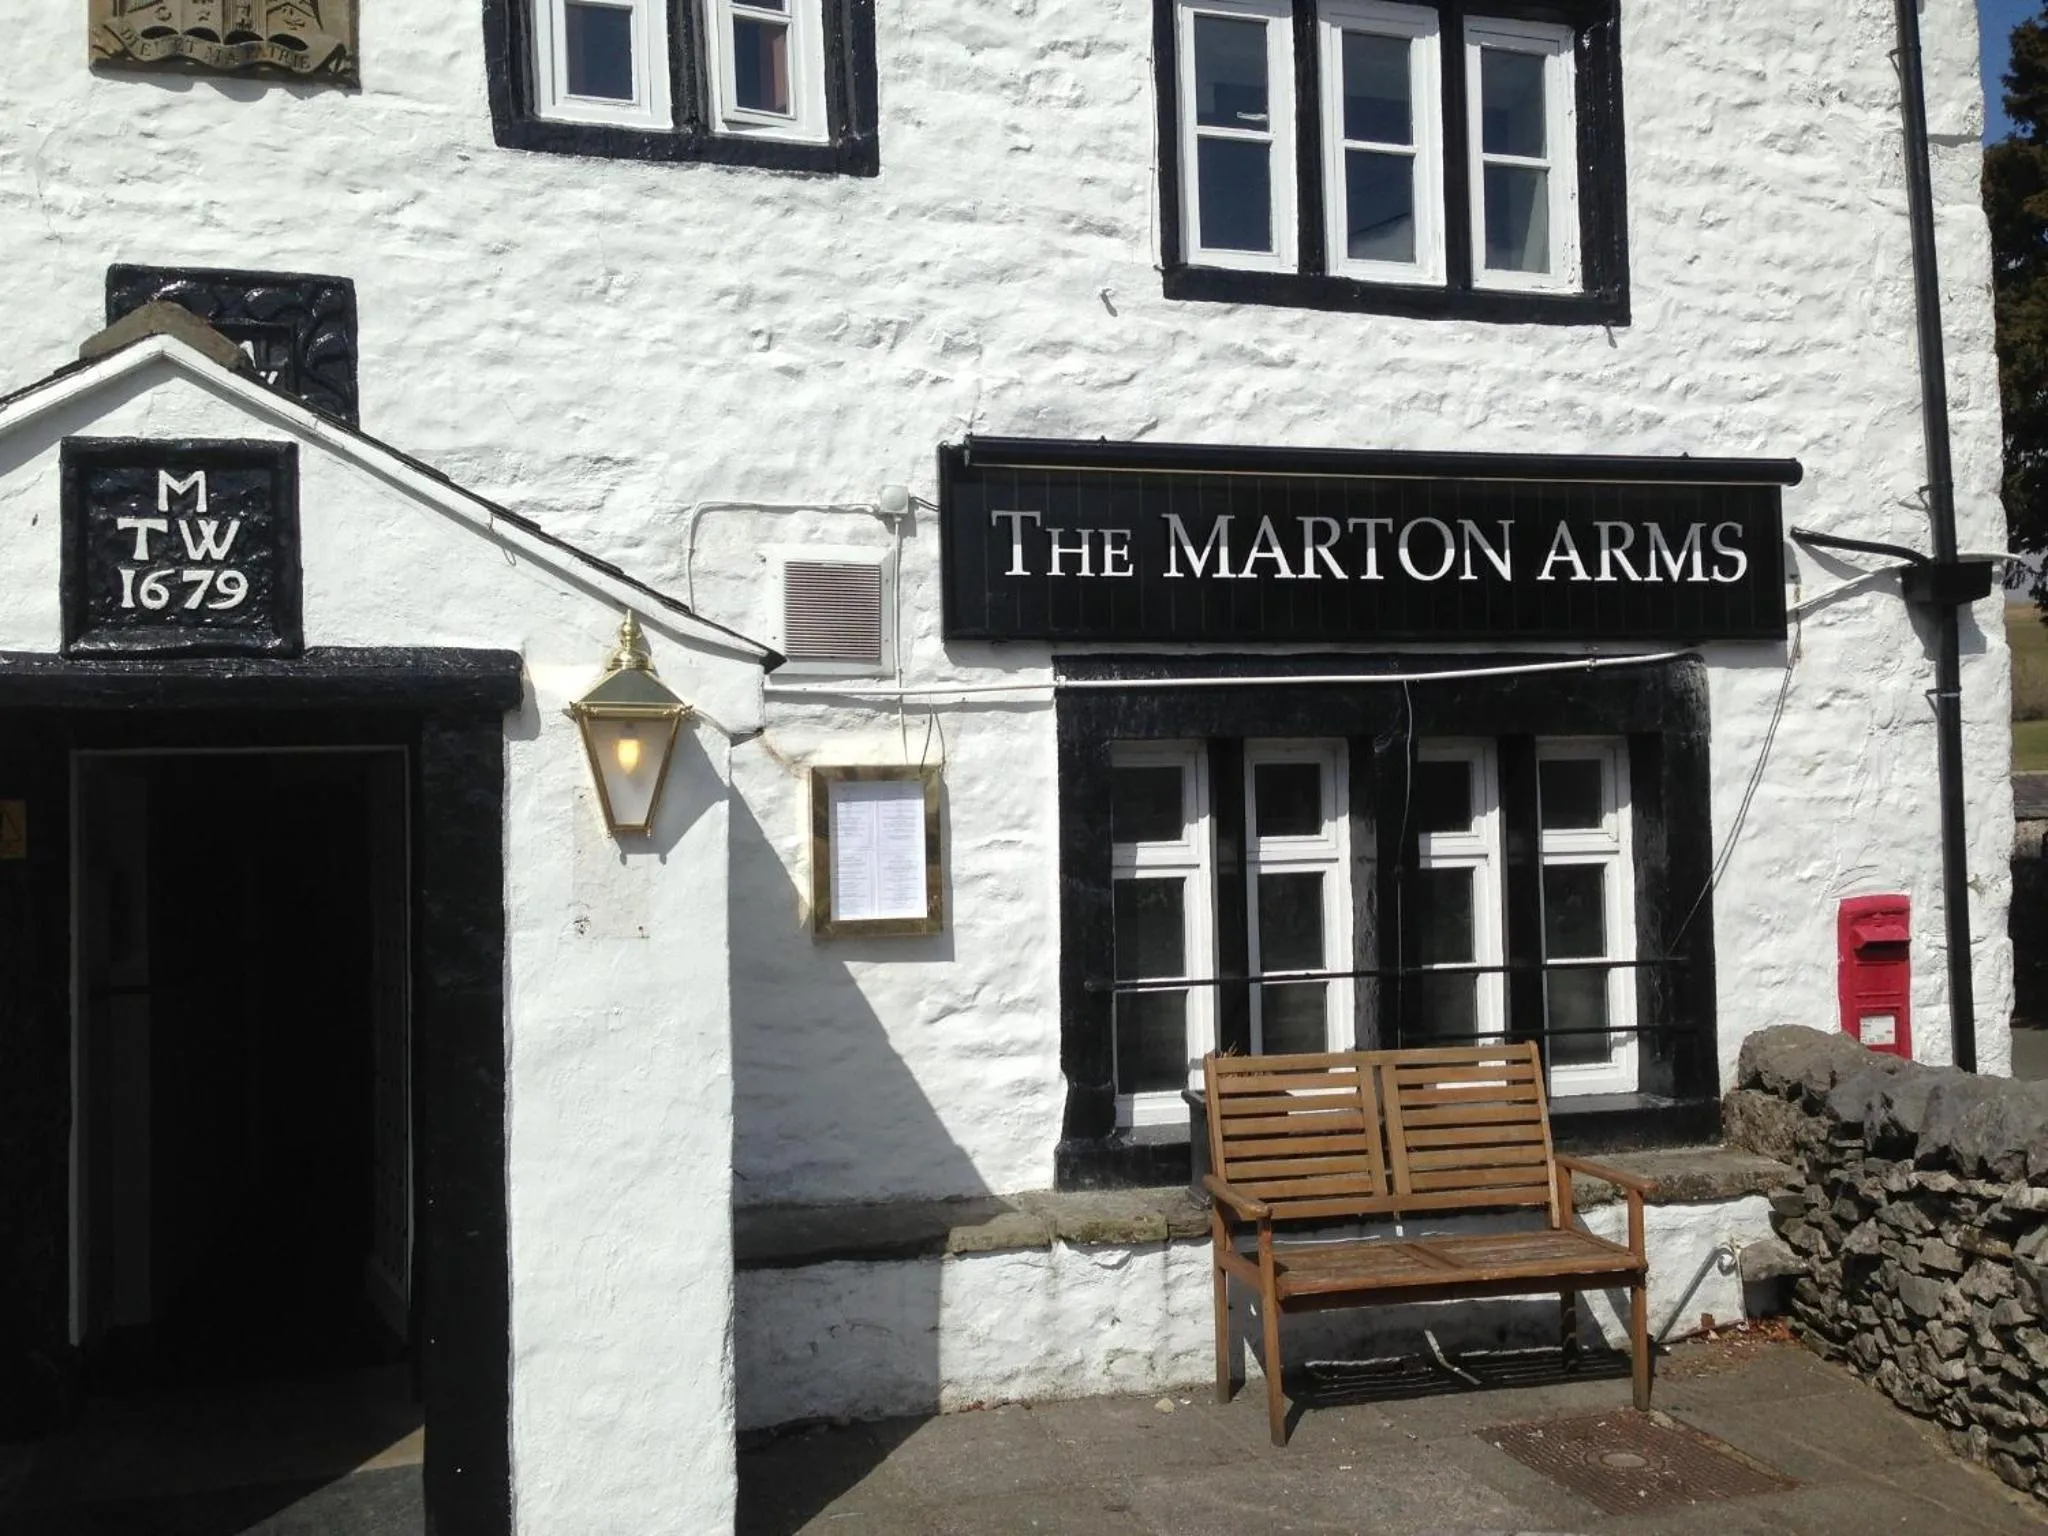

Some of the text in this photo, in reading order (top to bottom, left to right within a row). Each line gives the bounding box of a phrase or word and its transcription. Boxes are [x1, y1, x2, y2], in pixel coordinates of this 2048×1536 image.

[157, 469, 208, 513] M
[1161, 513, 1515, 582] MARTON
[1536, 519, 1748, 583] ARMS
[118, 568, 249, 610] 1679
